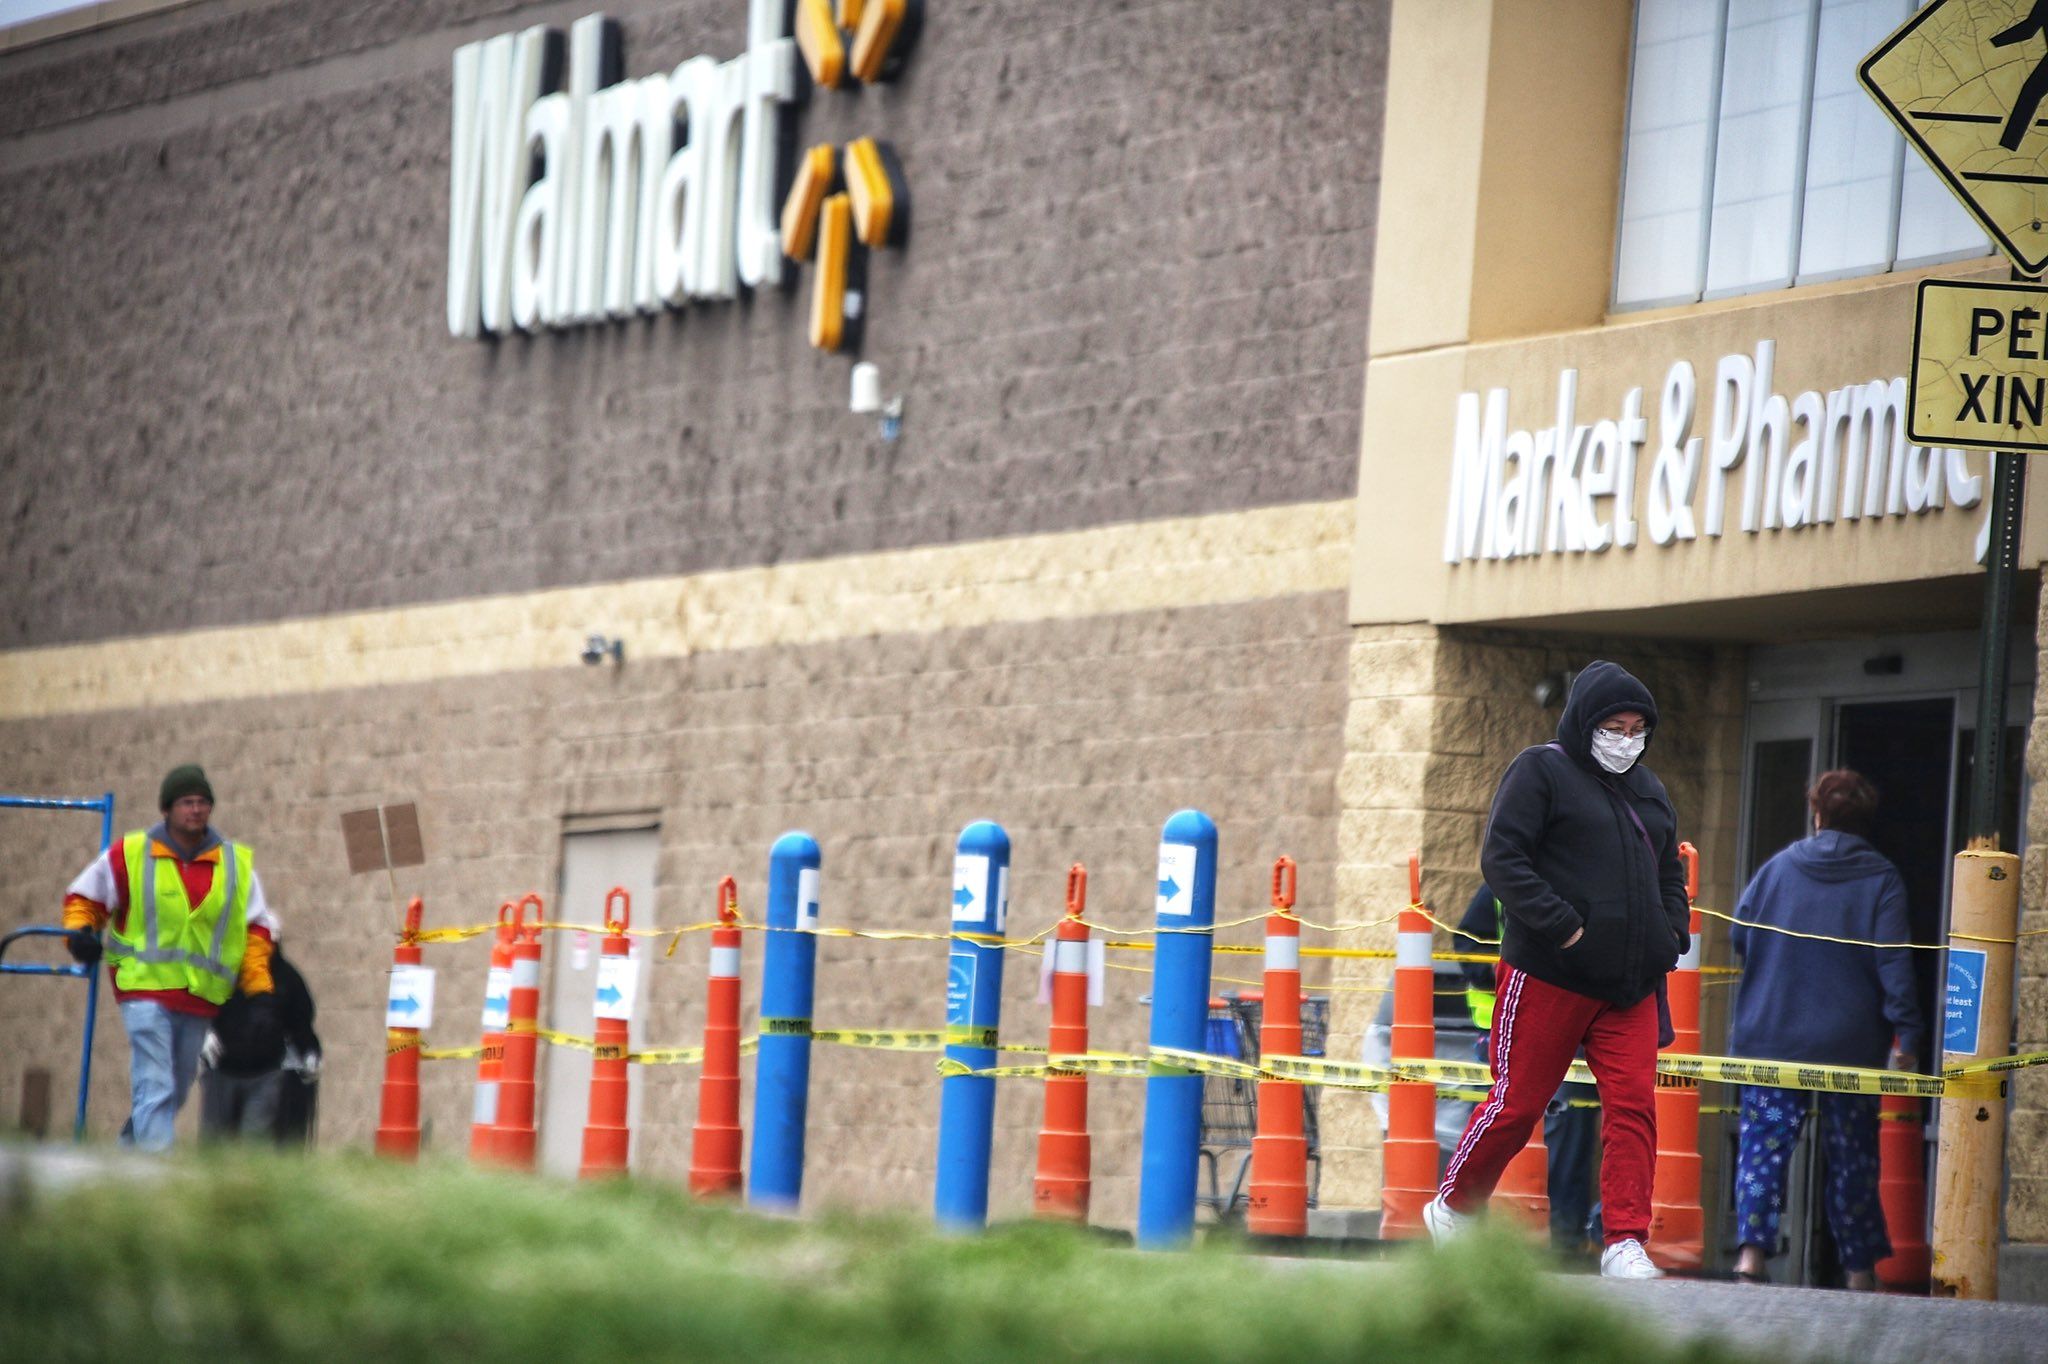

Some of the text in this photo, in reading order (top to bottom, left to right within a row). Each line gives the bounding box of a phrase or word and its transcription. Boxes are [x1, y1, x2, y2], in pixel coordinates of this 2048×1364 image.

[447, 0, 797, 338] Walmart
[1970, 307, 2048, 360] PE
[1444, 339, 1994, 565] Market & Pharma
[1953, 996, 1973, 1006] least
